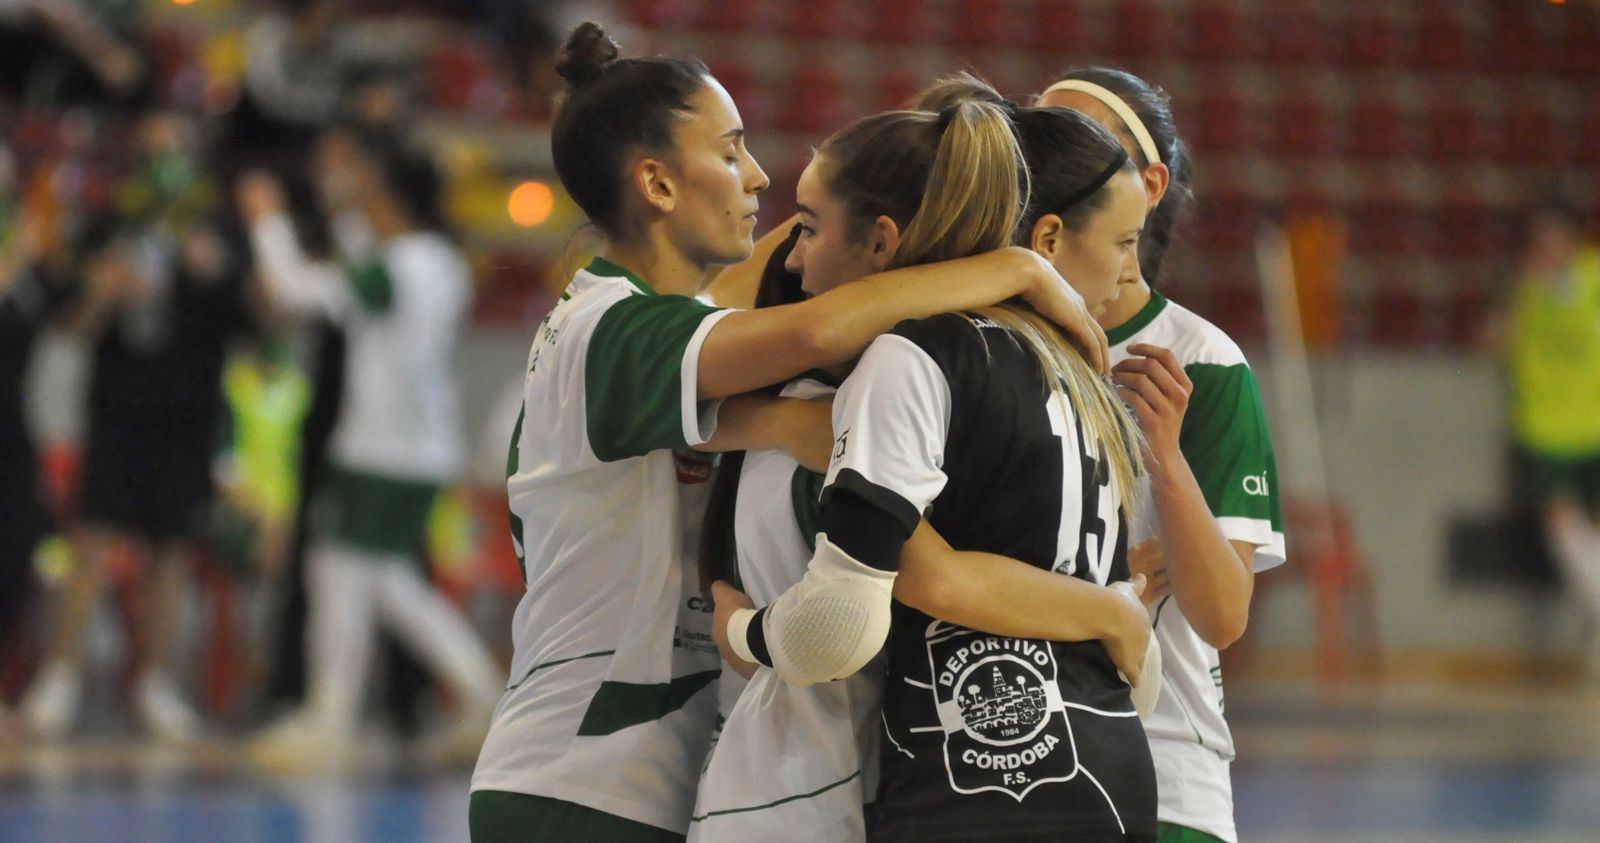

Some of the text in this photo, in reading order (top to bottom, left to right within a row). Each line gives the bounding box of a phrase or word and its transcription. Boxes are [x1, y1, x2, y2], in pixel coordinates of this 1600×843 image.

[939, 637, 1049, 687] DEPORTIVO
[1000, 728, 1020, 737] 1984
[962, 733, 1060, 770] CÓRDOBA
[1003, 771, 1031, 785] F.S.
